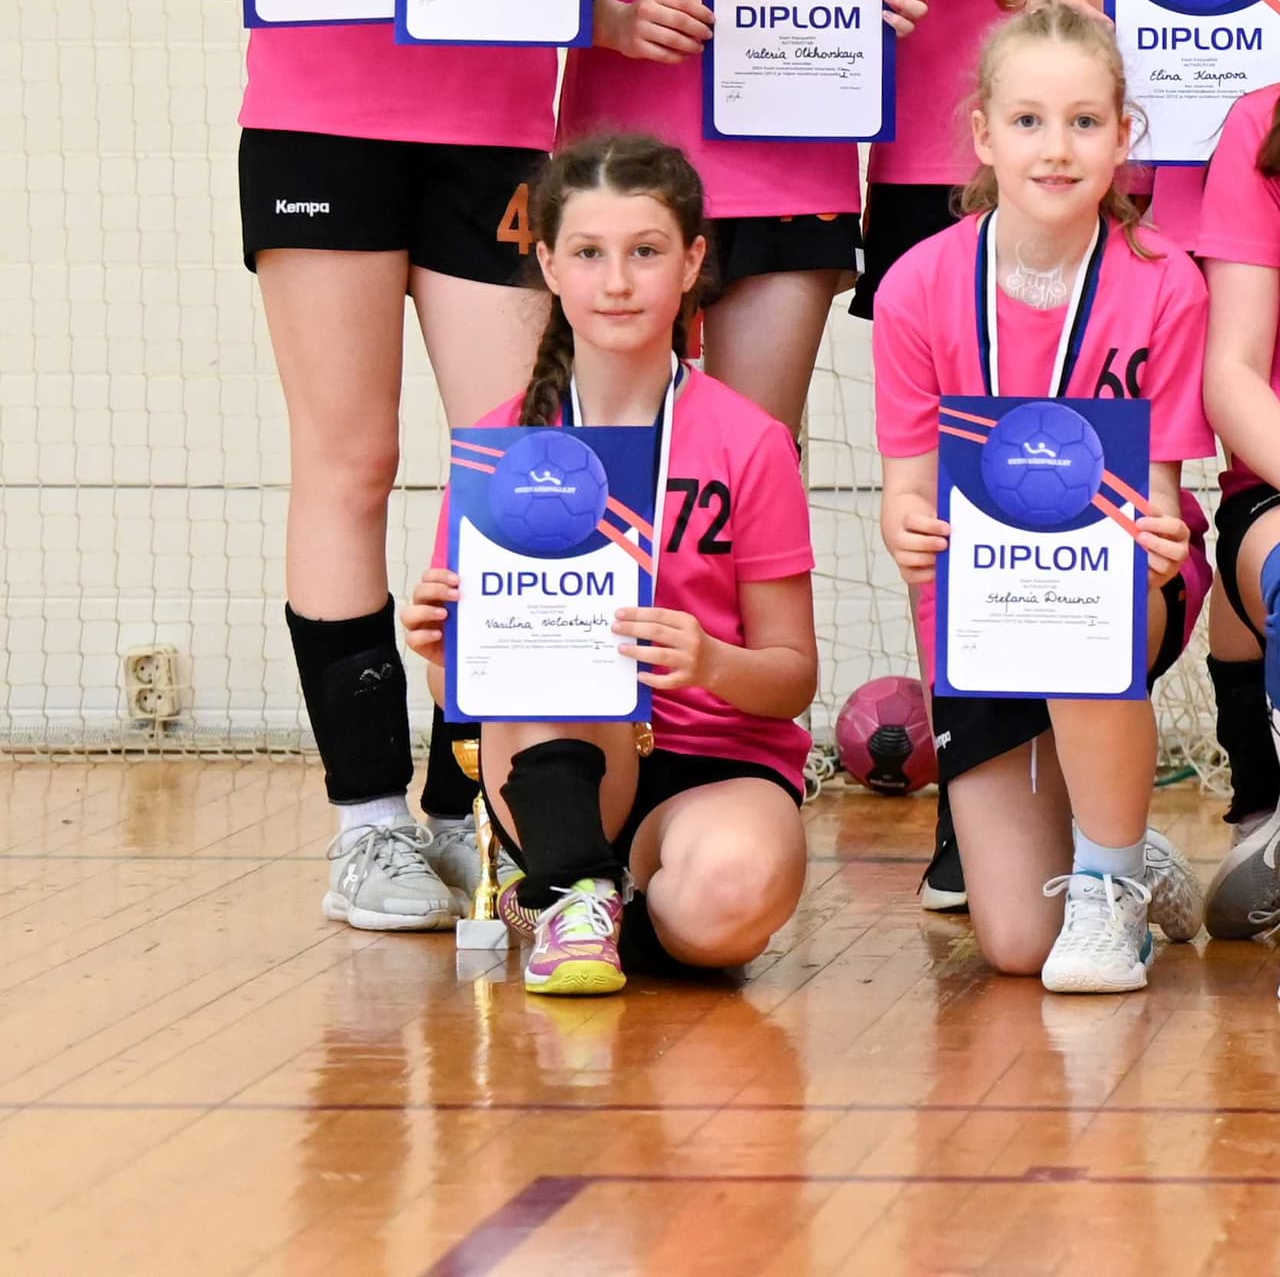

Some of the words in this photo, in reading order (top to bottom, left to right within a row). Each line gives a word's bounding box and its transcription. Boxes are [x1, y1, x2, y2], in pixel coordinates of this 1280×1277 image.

[735, 6, 861, 29] DIPLOM
[1137, 26, 1262, 51] DIPLOM
[745, 47, 787, 59] Valeria
[275, 198, 330, 217] Kempa
[665, 477, 734, 555] 72
[973, 544, 1109, 572] DIPLOM
[481, 571, 614, 596] DIPLOM
